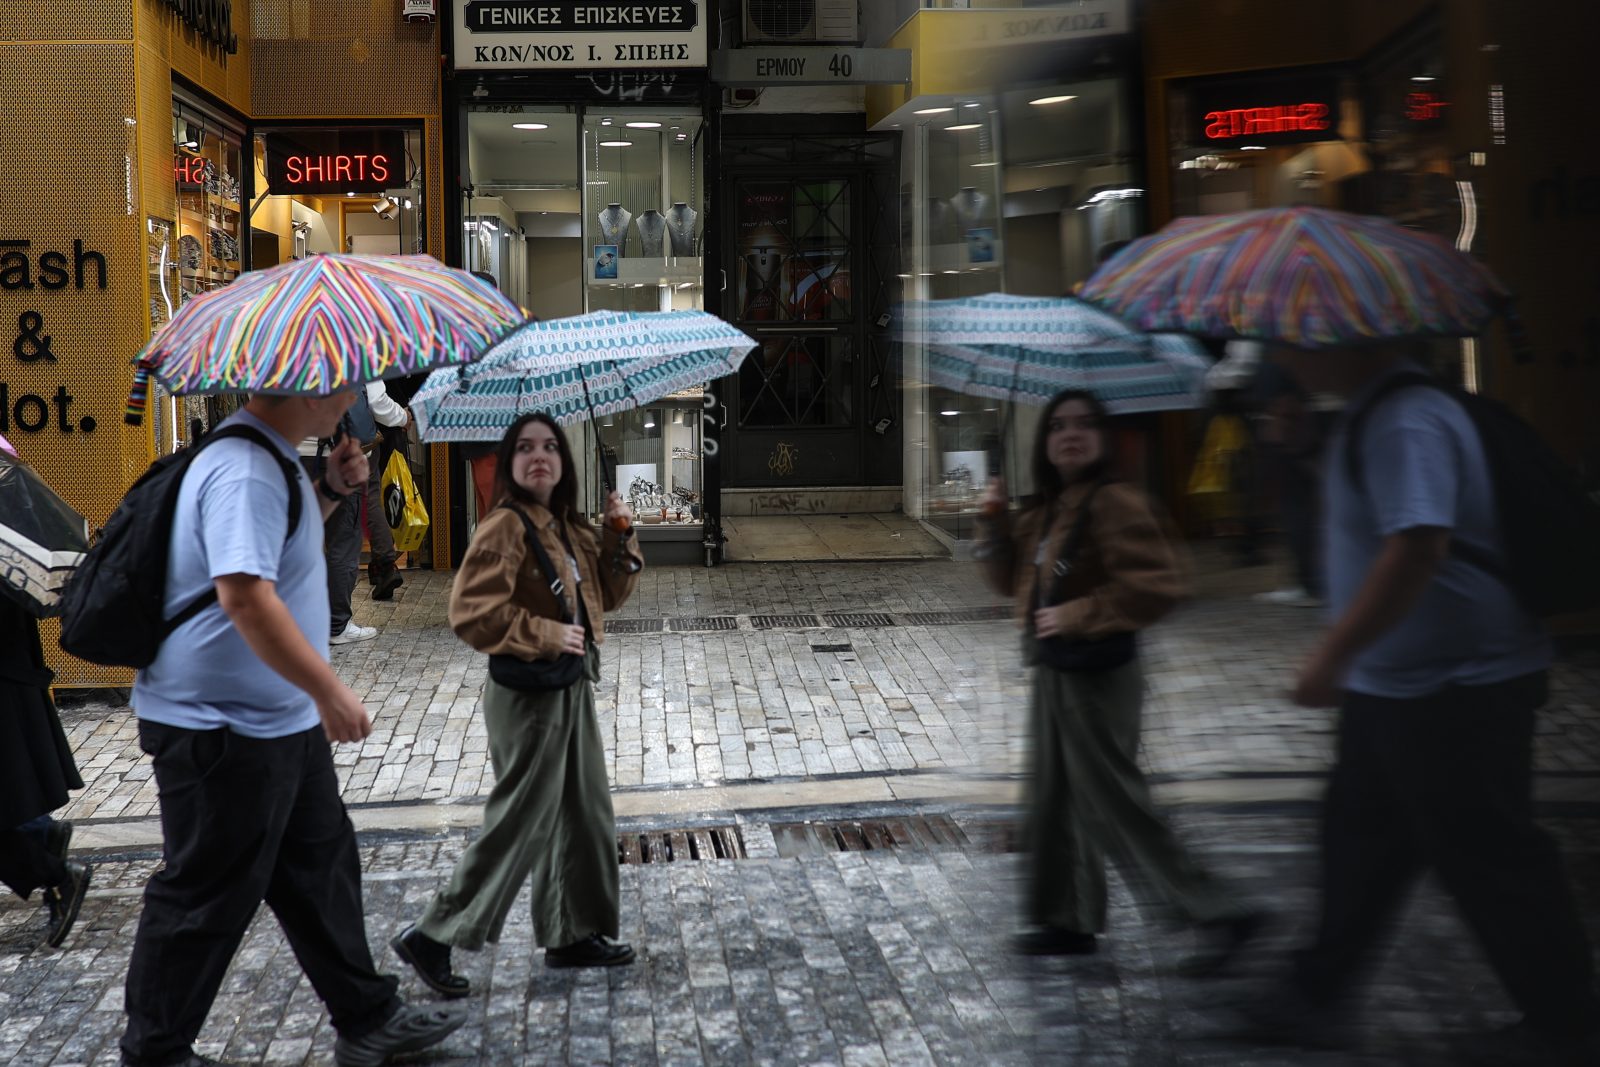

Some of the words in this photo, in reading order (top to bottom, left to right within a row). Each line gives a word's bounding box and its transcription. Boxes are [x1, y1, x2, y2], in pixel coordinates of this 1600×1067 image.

[479, 7, 562, 25] ΓΕΝΙΚΕΣ
[574, 6, 683, 24] ΕΠΙΣΚΕΥΕΣ
[474, 43, 574, 62] ΚΩΝ/ΝΟΣ
[587, 45, 602, 61] Ι.
[614, 43, 689, 61] ΣΠΕΗΣ
[756, 57, 806, 76] ΕΡΜΟΥ
[828, 53, 852, 77] 40
[286, 153, 390, 185] SHIRTS
[14, 310, 58, 363] &
